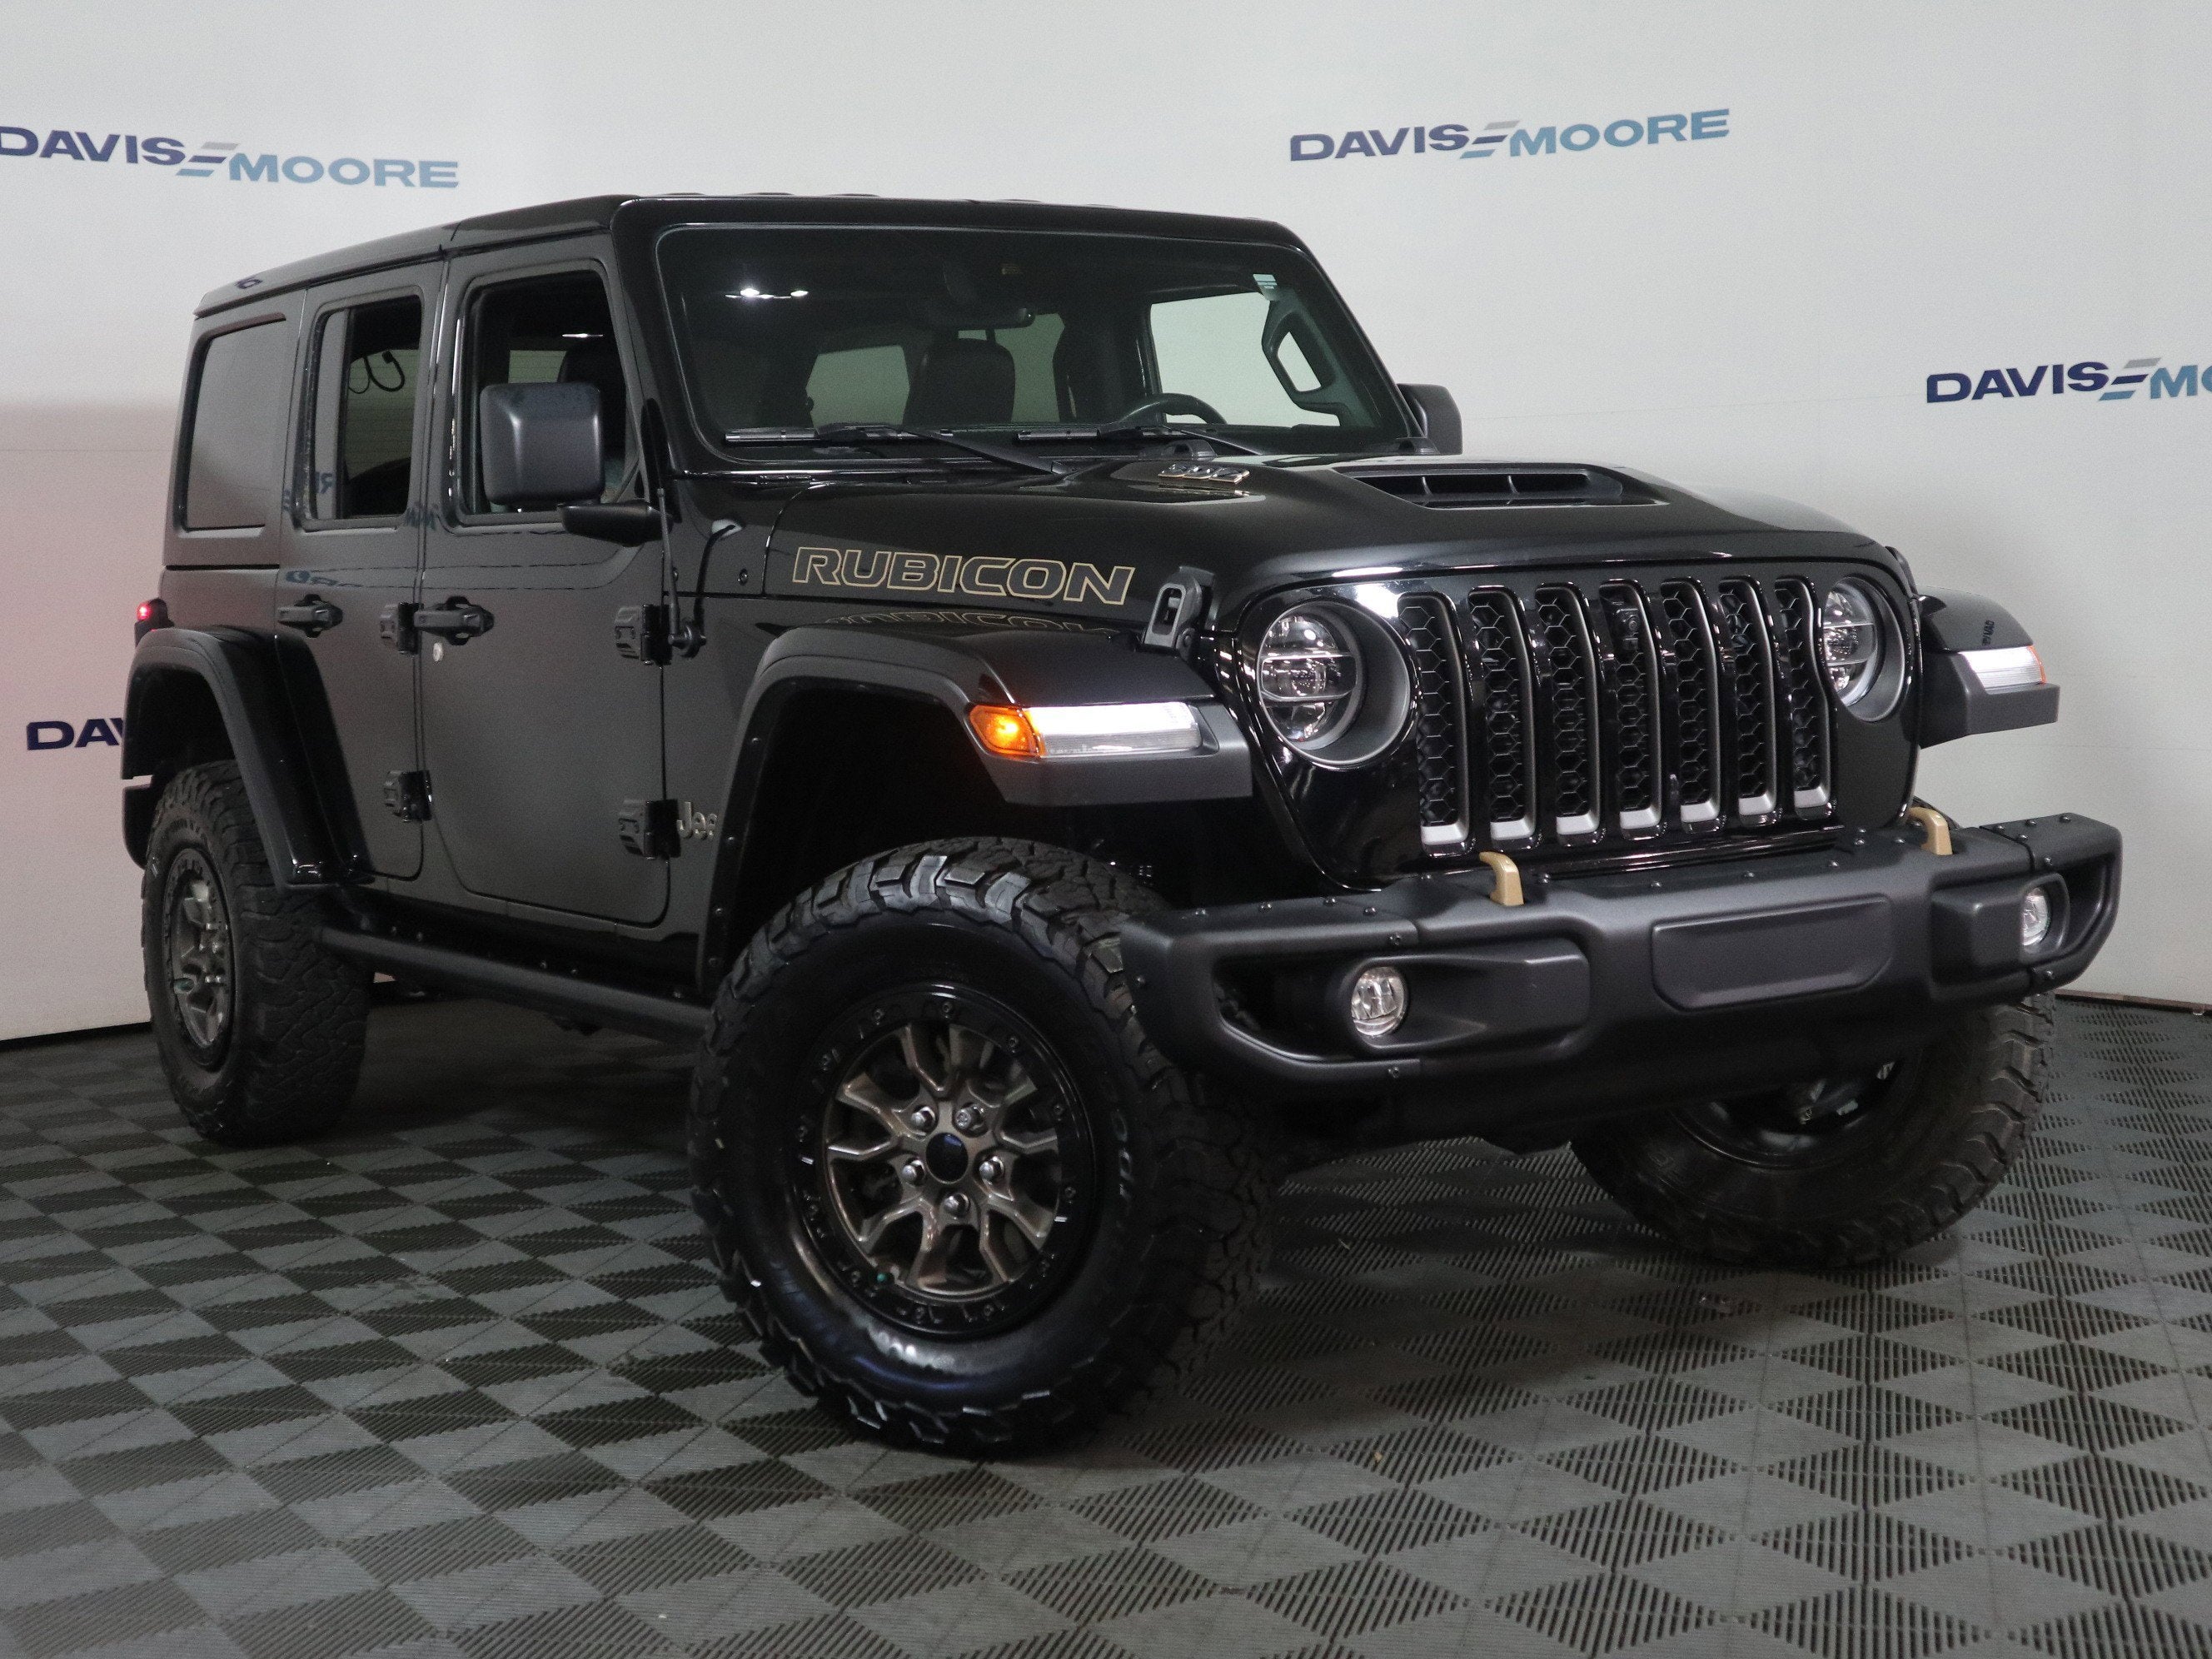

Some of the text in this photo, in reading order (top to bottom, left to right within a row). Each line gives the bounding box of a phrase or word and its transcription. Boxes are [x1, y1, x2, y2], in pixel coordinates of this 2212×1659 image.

[0, 126, 459, 188] DAVIS MOORE
[1289, 108, 1731, 162] DAVIS MOORE
[1926, 361, 2212, 403] DAVIS M
[792, 546, 1135, 605] RUBICON
